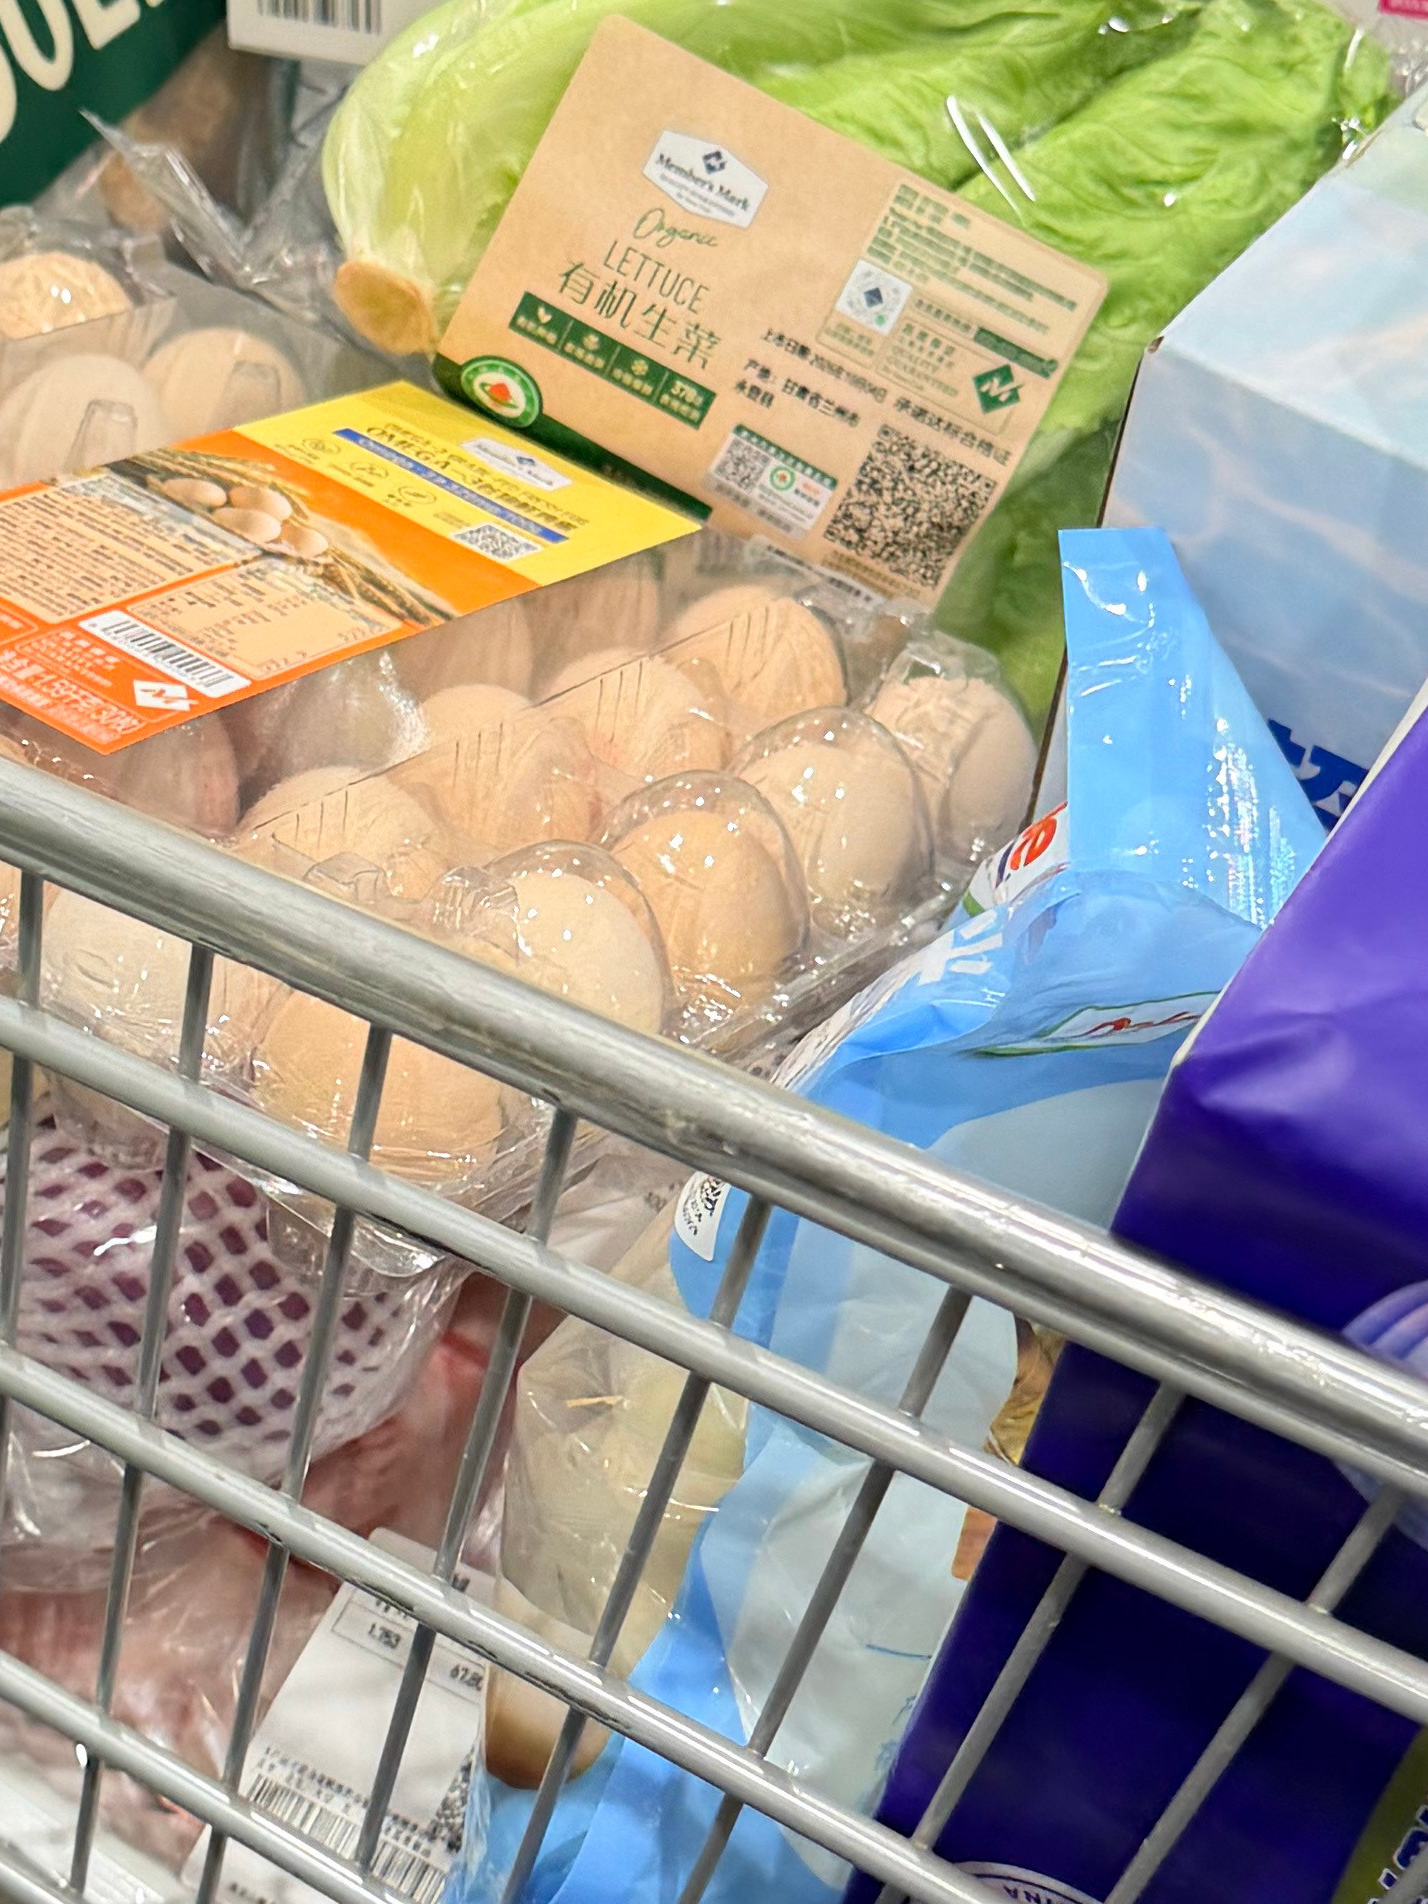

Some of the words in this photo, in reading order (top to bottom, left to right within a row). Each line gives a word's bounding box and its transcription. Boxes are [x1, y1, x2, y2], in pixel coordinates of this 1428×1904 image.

[718, 180, 750, 213] Mark
[633, 207, 719, 248] Organic
[603, 240, 710, 315] LETTUCE
[558, 260, 722, 370] 有机生菜
